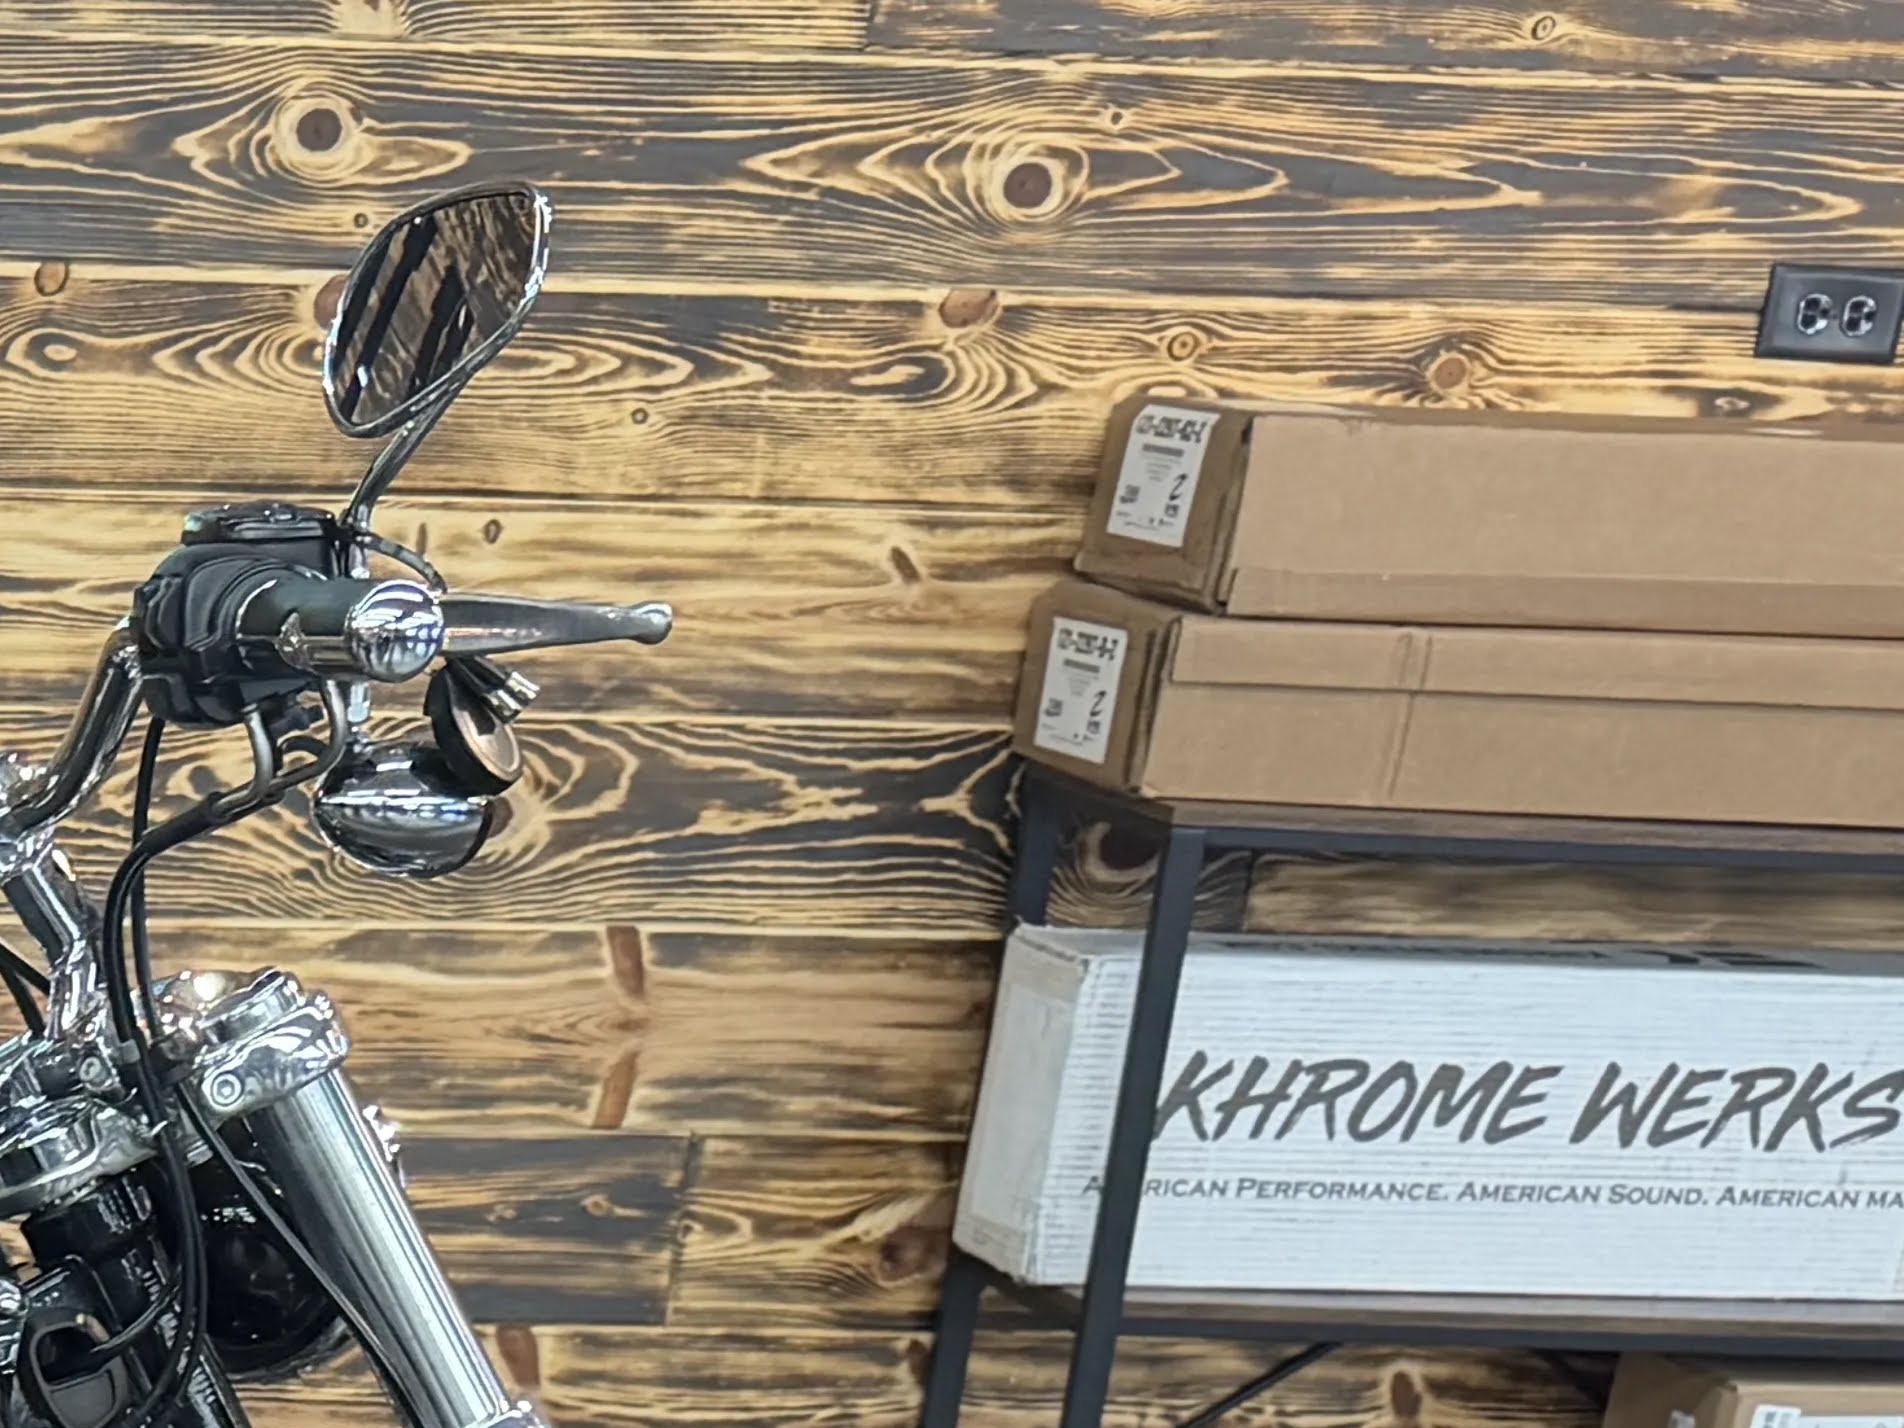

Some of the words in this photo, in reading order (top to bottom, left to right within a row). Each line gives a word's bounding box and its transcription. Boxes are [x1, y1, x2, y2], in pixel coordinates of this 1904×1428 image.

[1151, 1050, 1563, 1145] KHROME
[1568, 1060, 1904, 1153] WERKS
[1082, 1176, 1230, 1199] ARICAN
[1234, 1176, 1450, 1202] PERFORMANCE.
[1456, 1180, 1602, 1204] AMERICAN
[1607, 1183, 1710, 1207] SOUND.
[1715, 1185, 1862, 1209] AMERICAN
